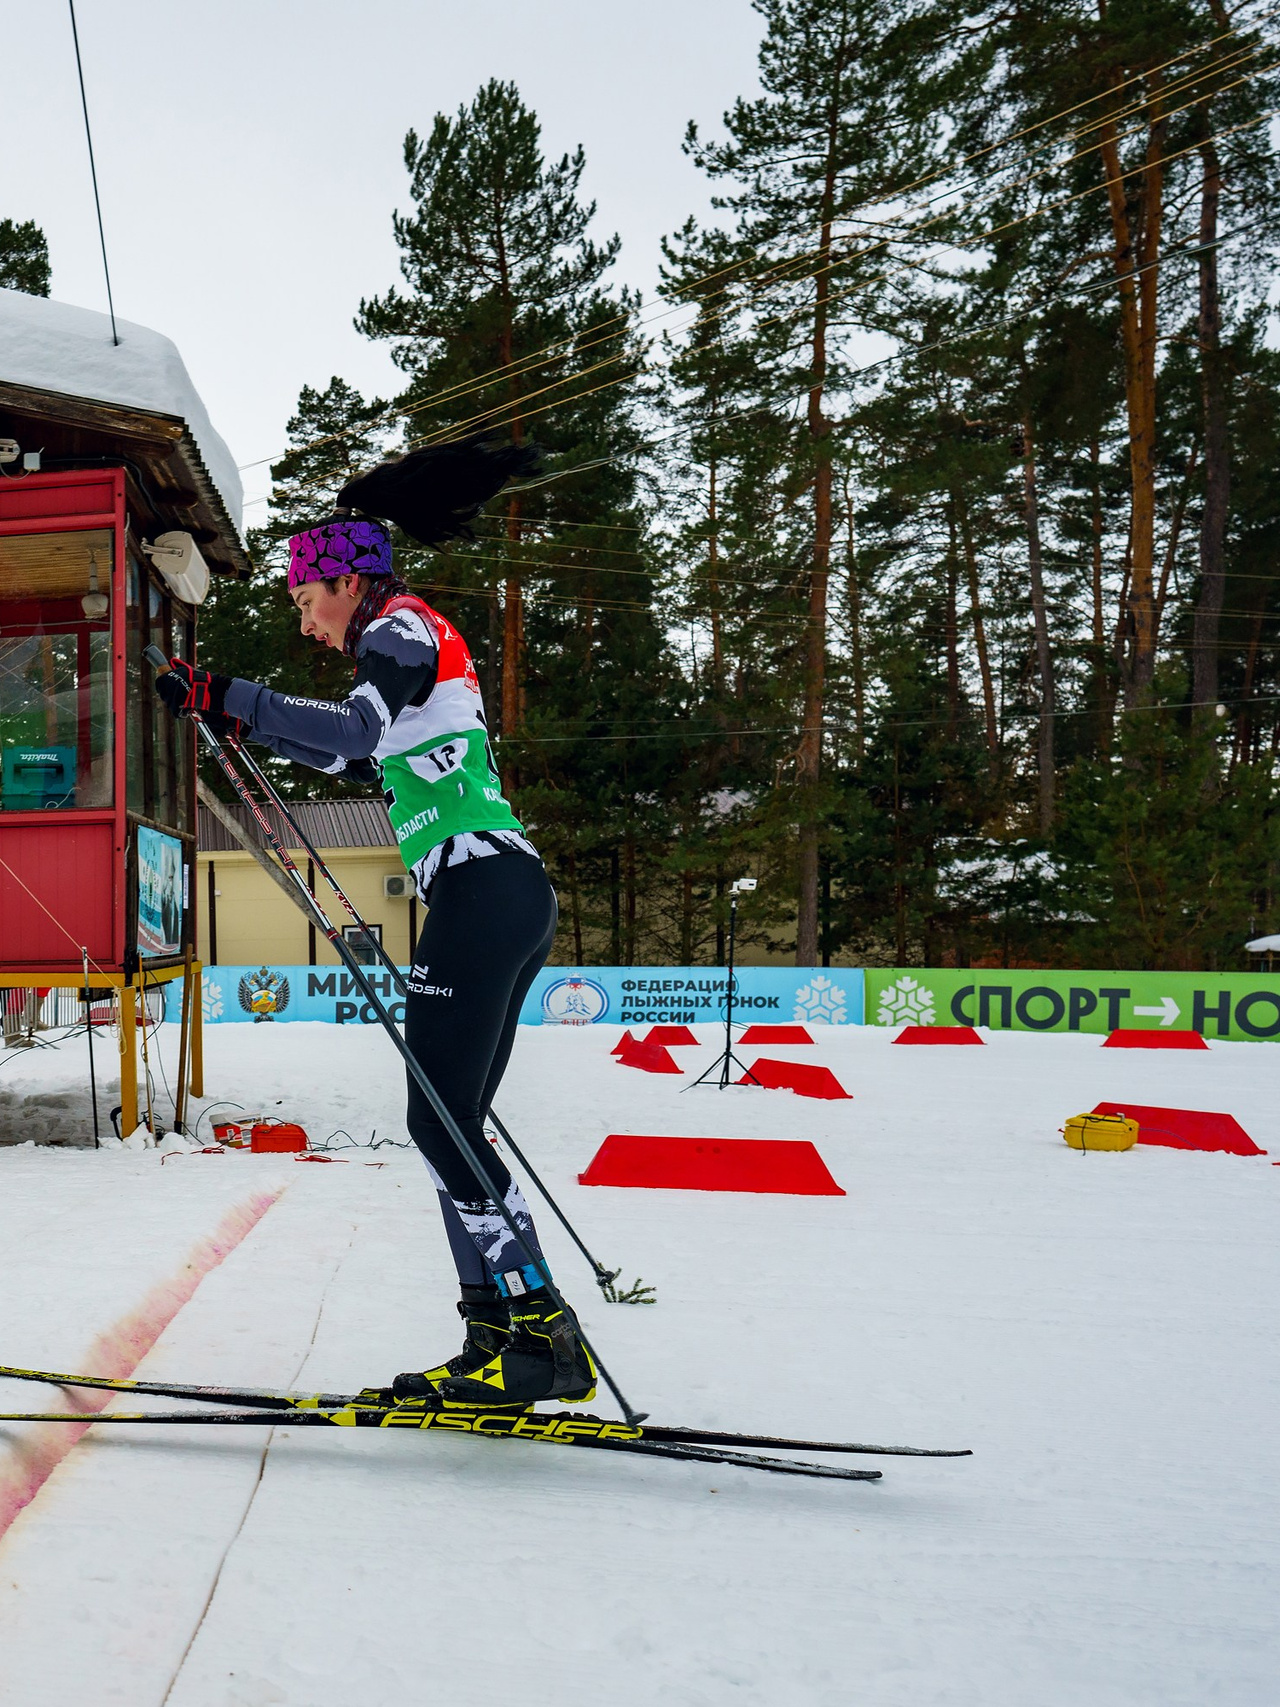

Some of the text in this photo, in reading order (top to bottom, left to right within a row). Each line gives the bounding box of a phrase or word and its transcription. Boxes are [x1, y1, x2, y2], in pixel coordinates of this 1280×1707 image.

[283, 696, 351, 717] NORDSKI
[621, 979, 736, 993] ФЕДЕРАЦИЯ
[621, 995, 780, 1009] ЛЫЖНЫХ ГОНОК
[621, 1011, 695, 1023] РОССИИ
[950, 984, 1280, 1038] СПОРТ НО
[379, 1411, 644, 1441] FISCHER
